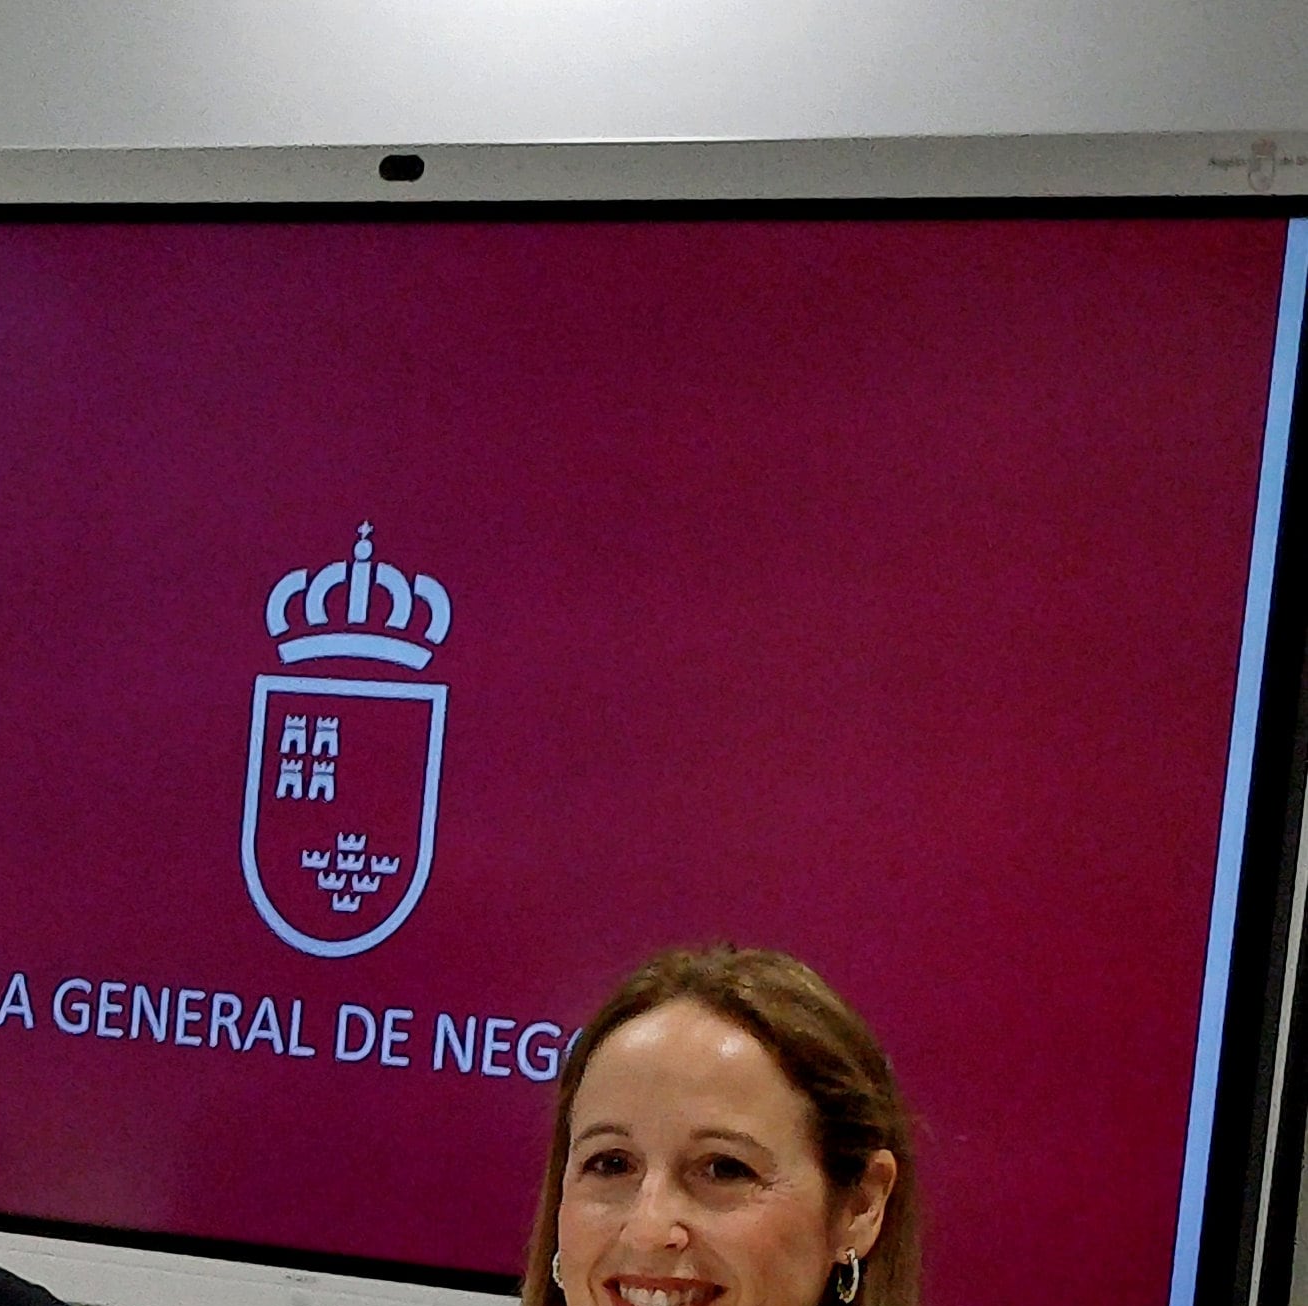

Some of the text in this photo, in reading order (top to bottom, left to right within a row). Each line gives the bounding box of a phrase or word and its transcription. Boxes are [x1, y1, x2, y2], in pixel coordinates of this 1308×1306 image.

[53, 978, 316, 1057] GENERAL
[336, 1004, 414, 1067] DE
[433, 1013, 583, 1082] NEG
